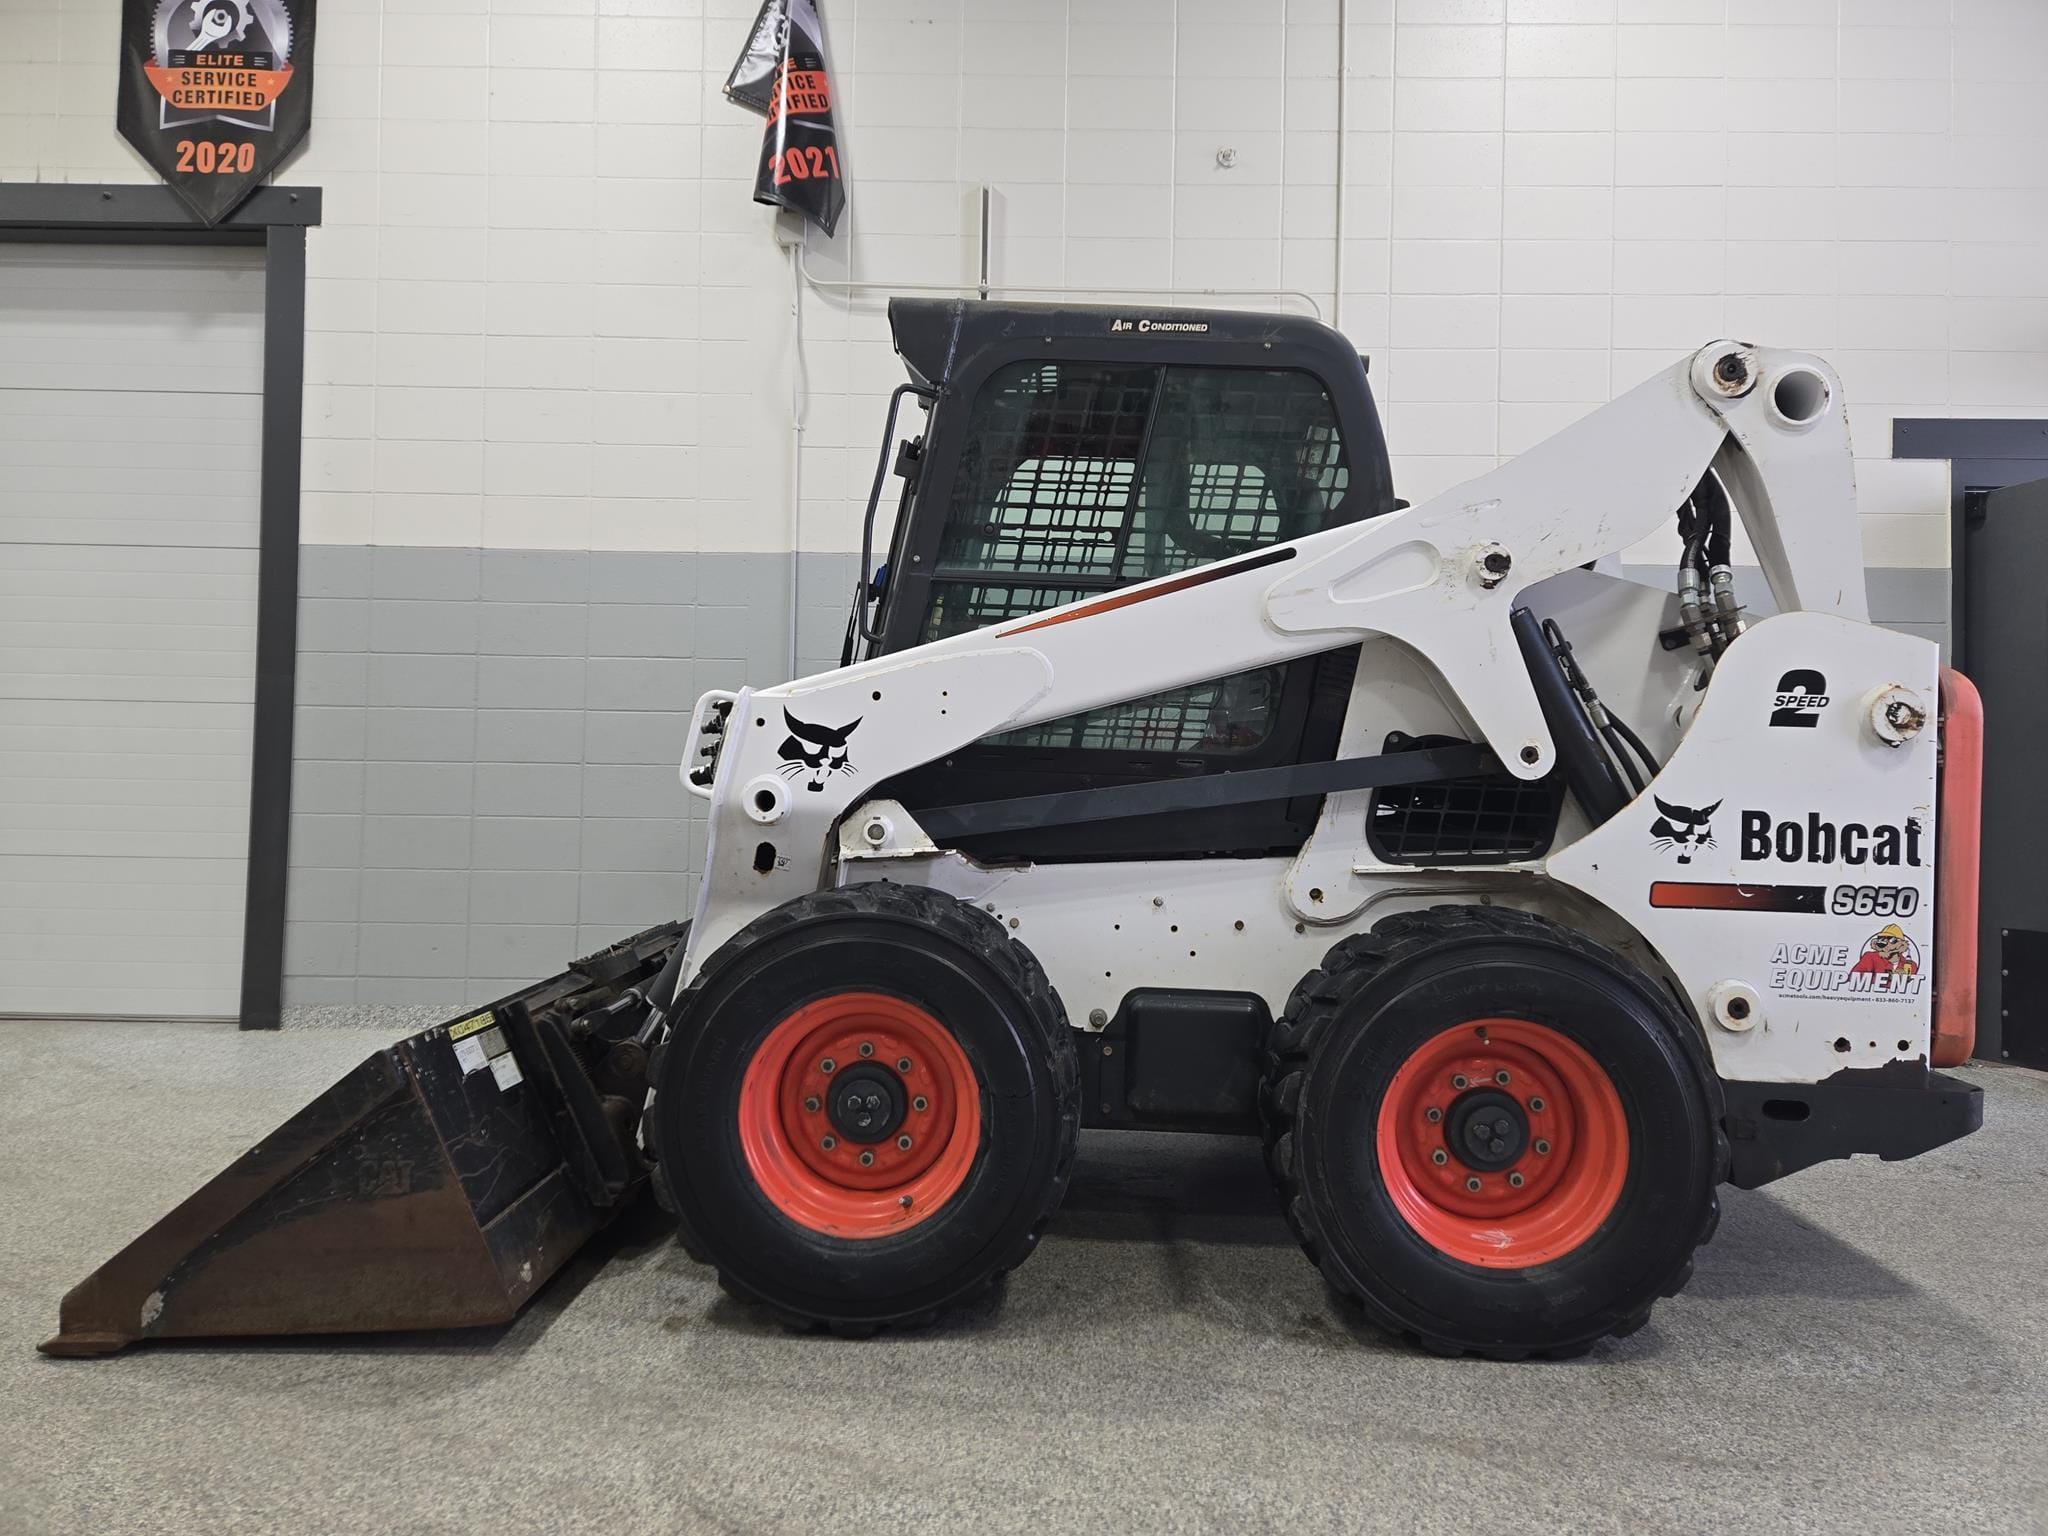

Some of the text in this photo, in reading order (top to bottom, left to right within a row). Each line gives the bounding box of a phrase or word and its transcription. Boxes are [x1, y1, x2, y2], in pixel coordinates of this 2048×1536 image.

[196, 54, 244, 66] ELITE
[181, 71, 257, 87] SERVICE
[172, 89, 266, 106] CERTIFIED
[176, 140, 256, 174] 2020
[768, 146, 840, 186] 2021
[1769, 669, 1827, 728] 2
[1773, 694, 1830, 708] SPEED
[1740, 810, 1922, 867] Bobcat
[1831, 884, 1919, 918] S650
[1769, 943, 1849, 967] ACME
[1769, 968, 1927, 996] EQUIPMENT
